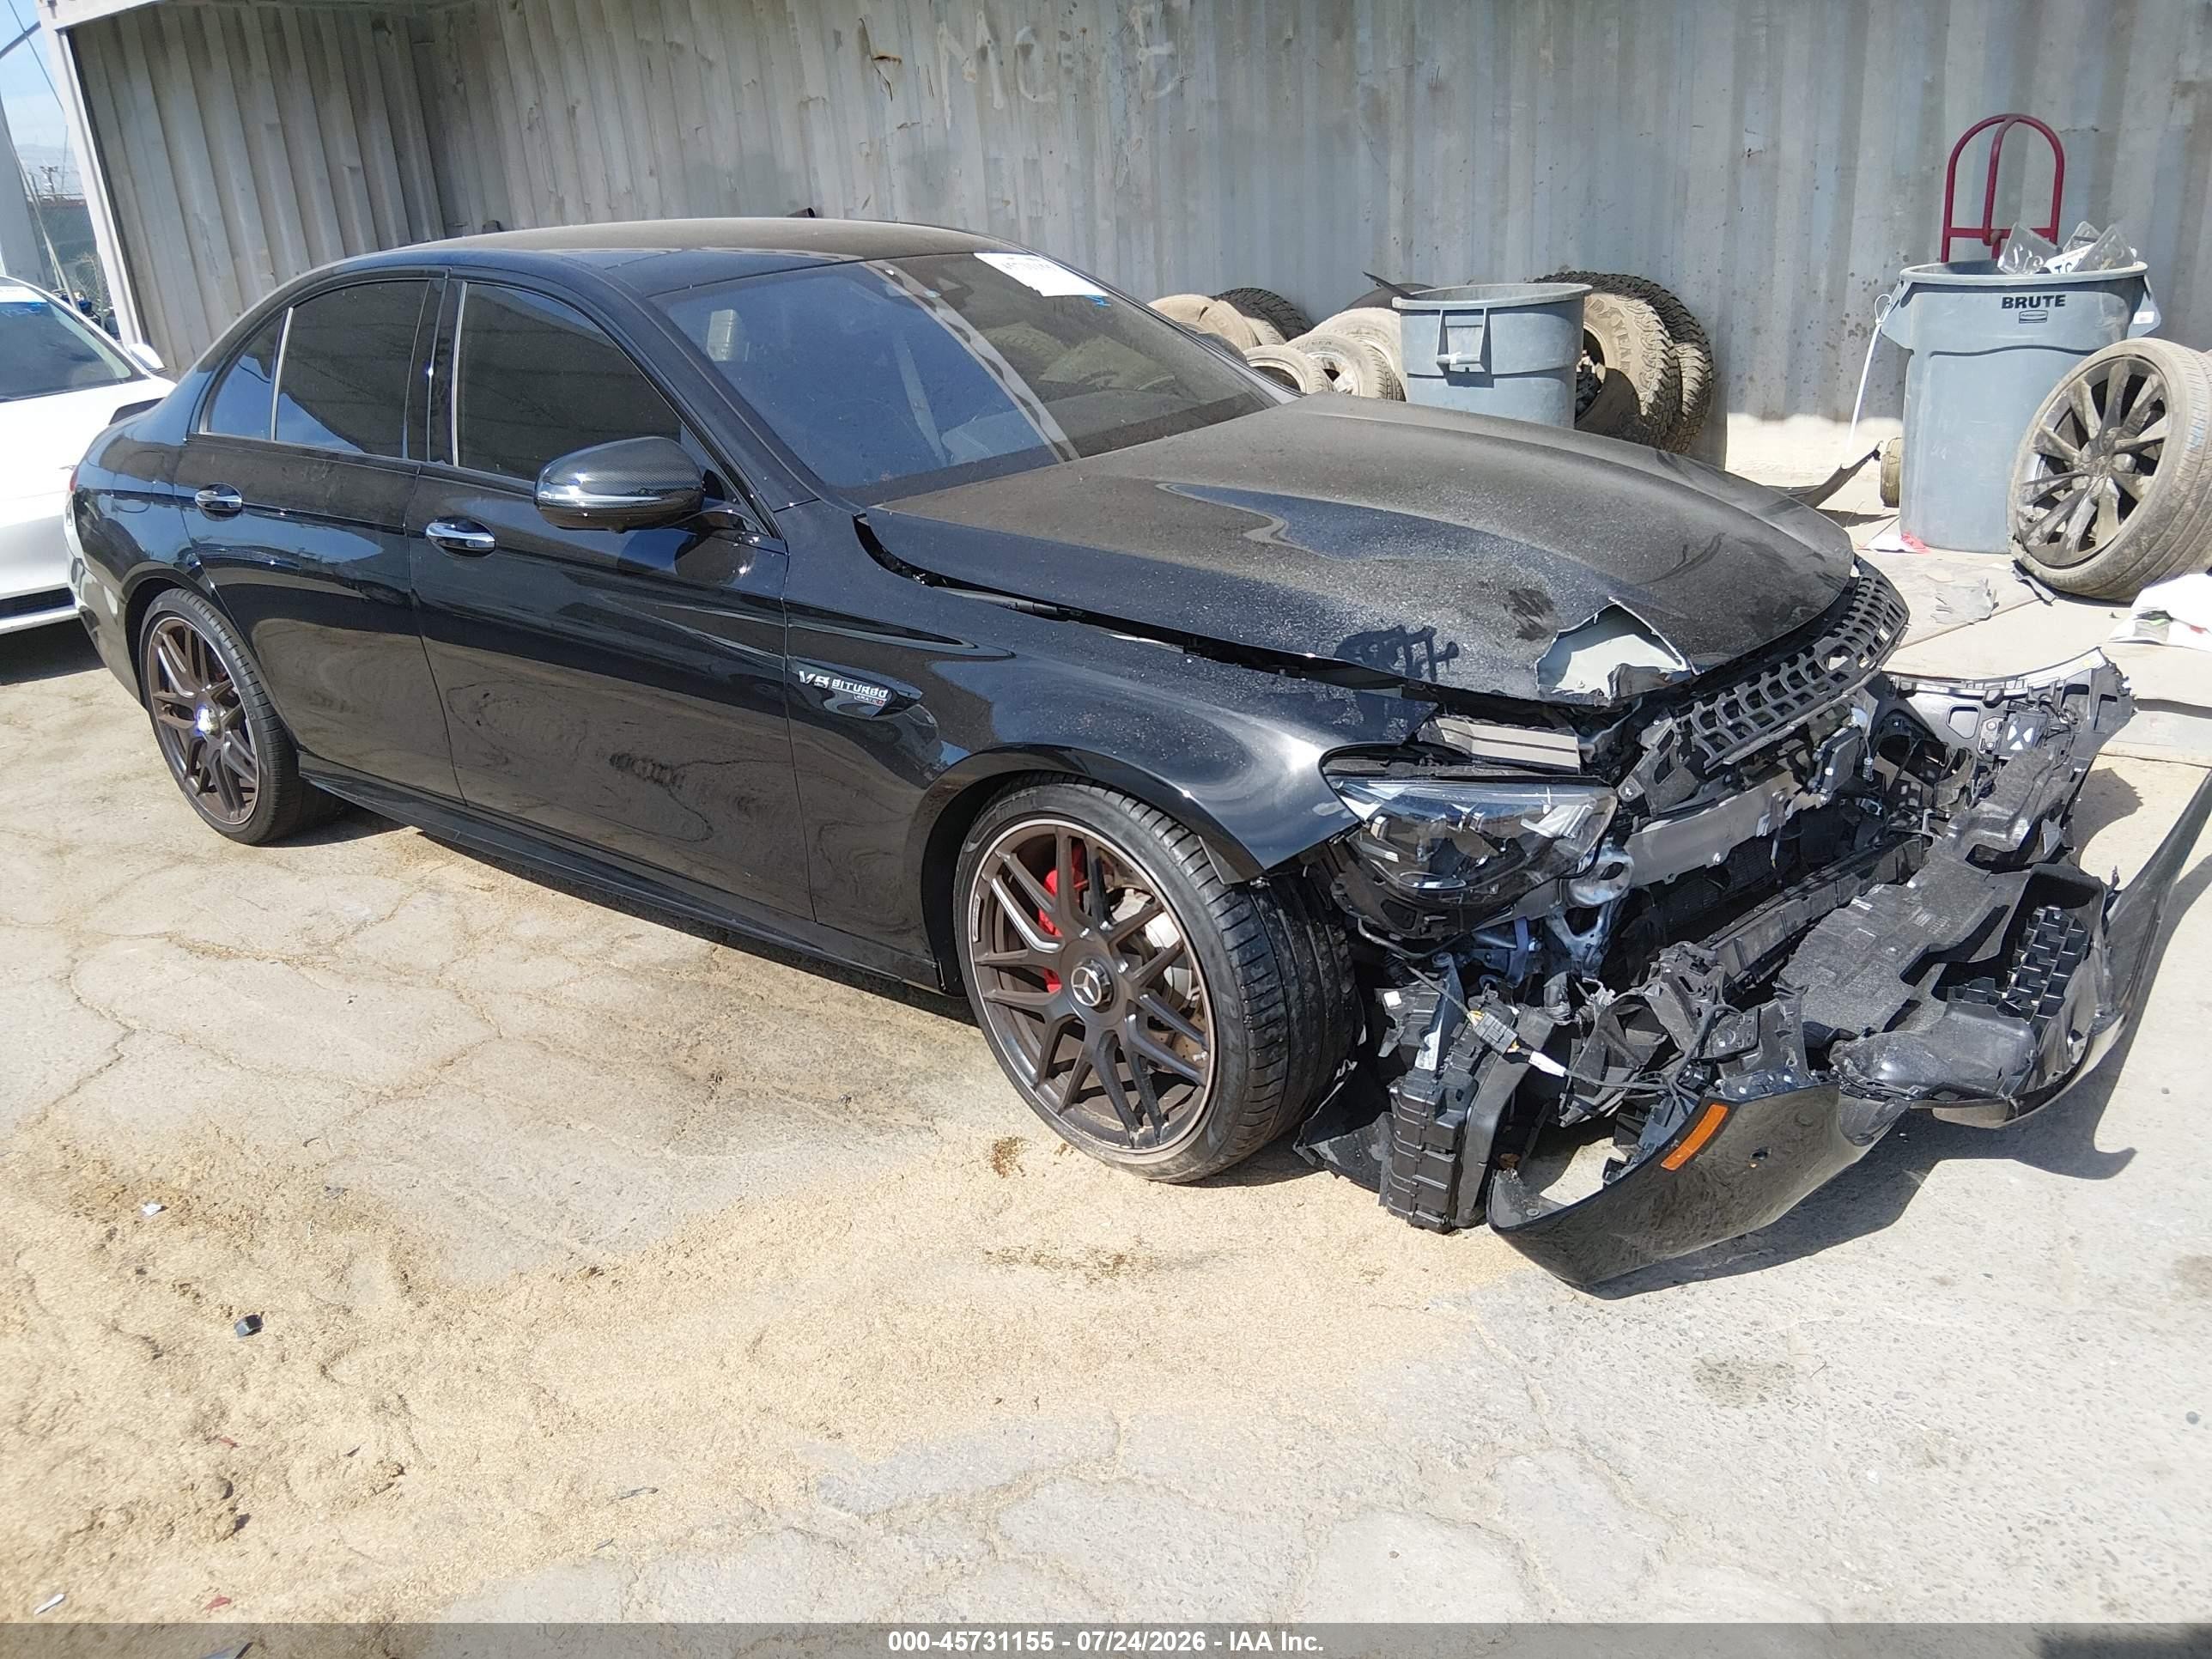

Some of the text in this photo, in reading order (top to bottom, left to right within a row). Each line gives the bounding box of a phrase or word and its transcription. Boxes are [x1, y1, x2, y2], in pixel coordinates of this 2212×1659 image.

[2001, 294, 2067, 309] BRUTE
[799, 671, 889, 698] V8 BITURBO
